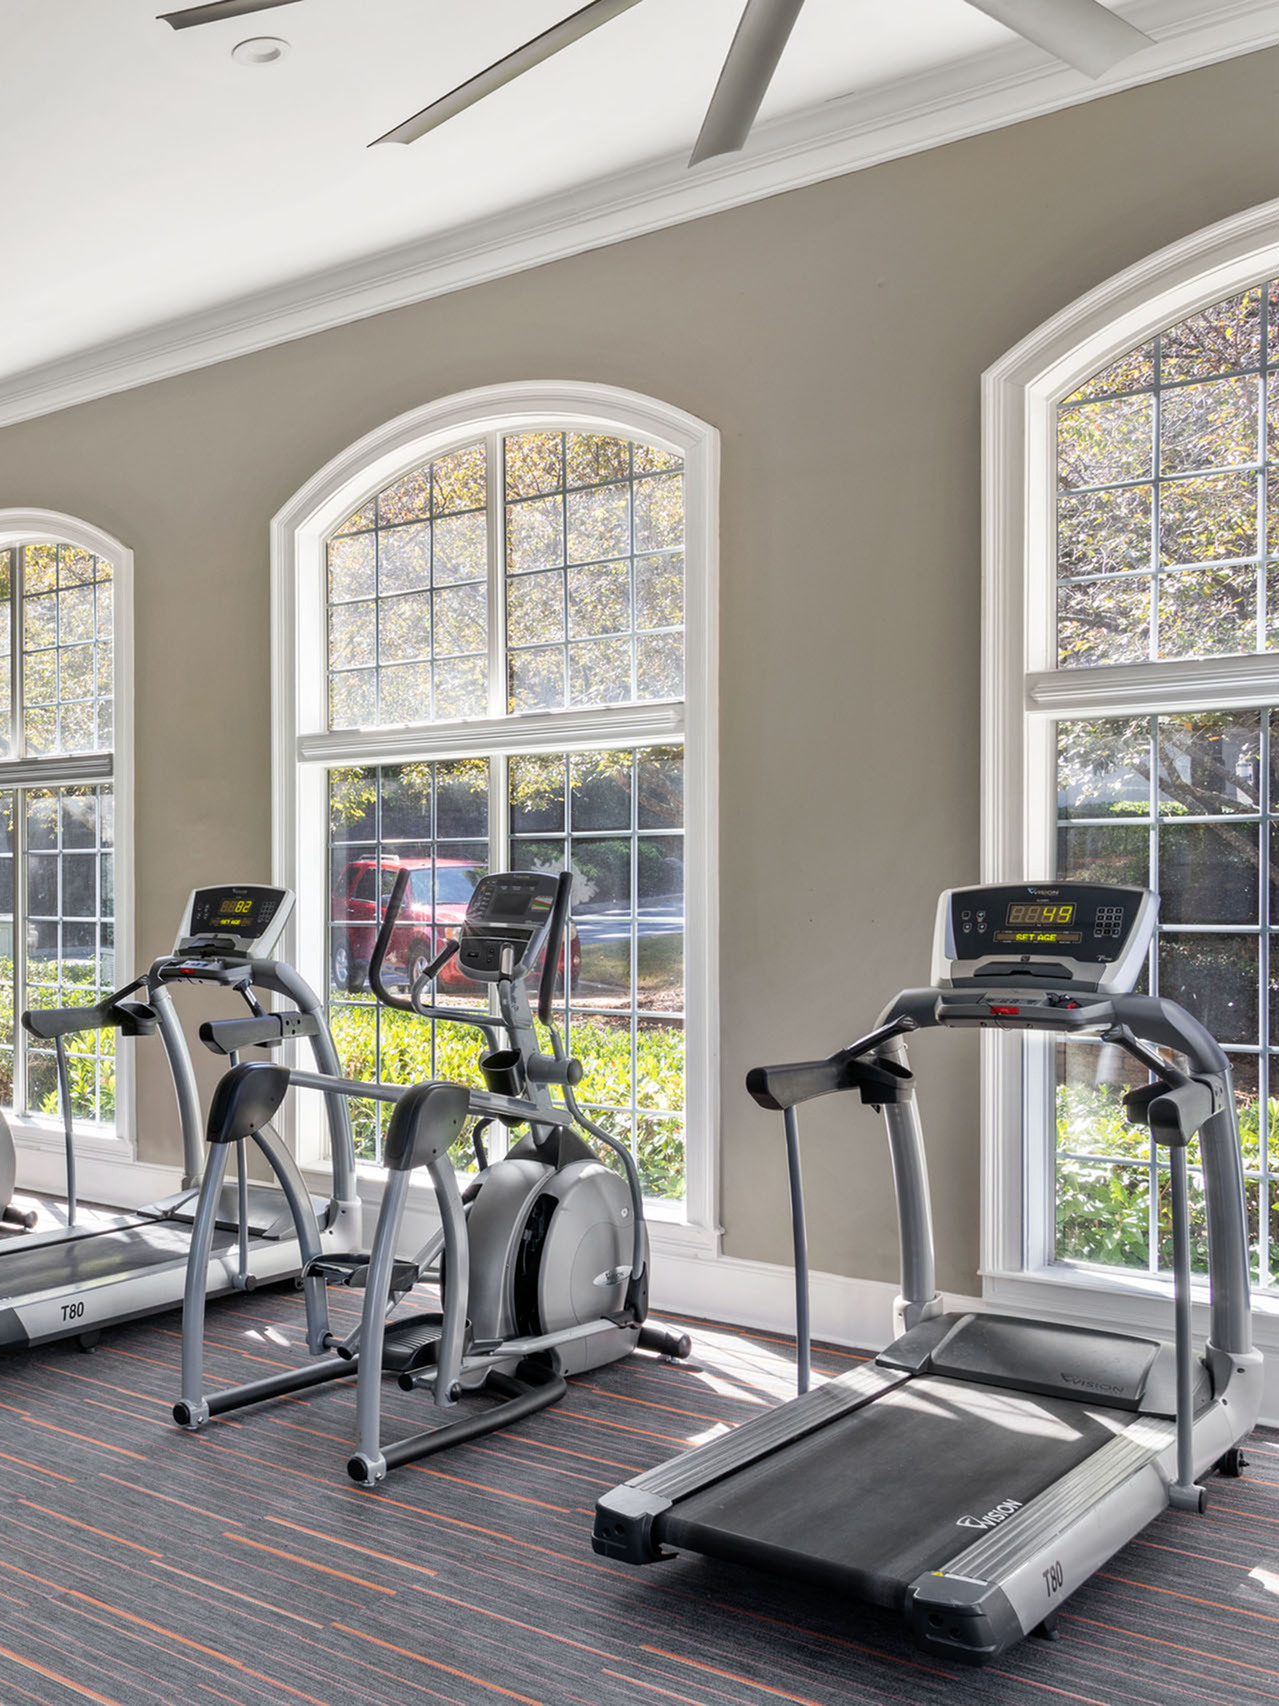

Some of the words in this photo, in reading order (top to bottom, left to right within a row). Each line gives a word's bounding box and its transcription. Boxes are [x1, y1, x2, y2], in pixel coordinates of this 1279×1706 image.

[235, 900, 253, 913] 82
[1043, 905, 1073, 923] 49
[1015, 933, 1036, 941] SET
[1037, 933, 1057, 942] AGE
[61, 1301, 84, 1321] T80
[1069, 1377, 1125, 1394] VISION
[973, 1498, 1024, 1528] VISION
[1042, 1560, 1064, 1597] T80
